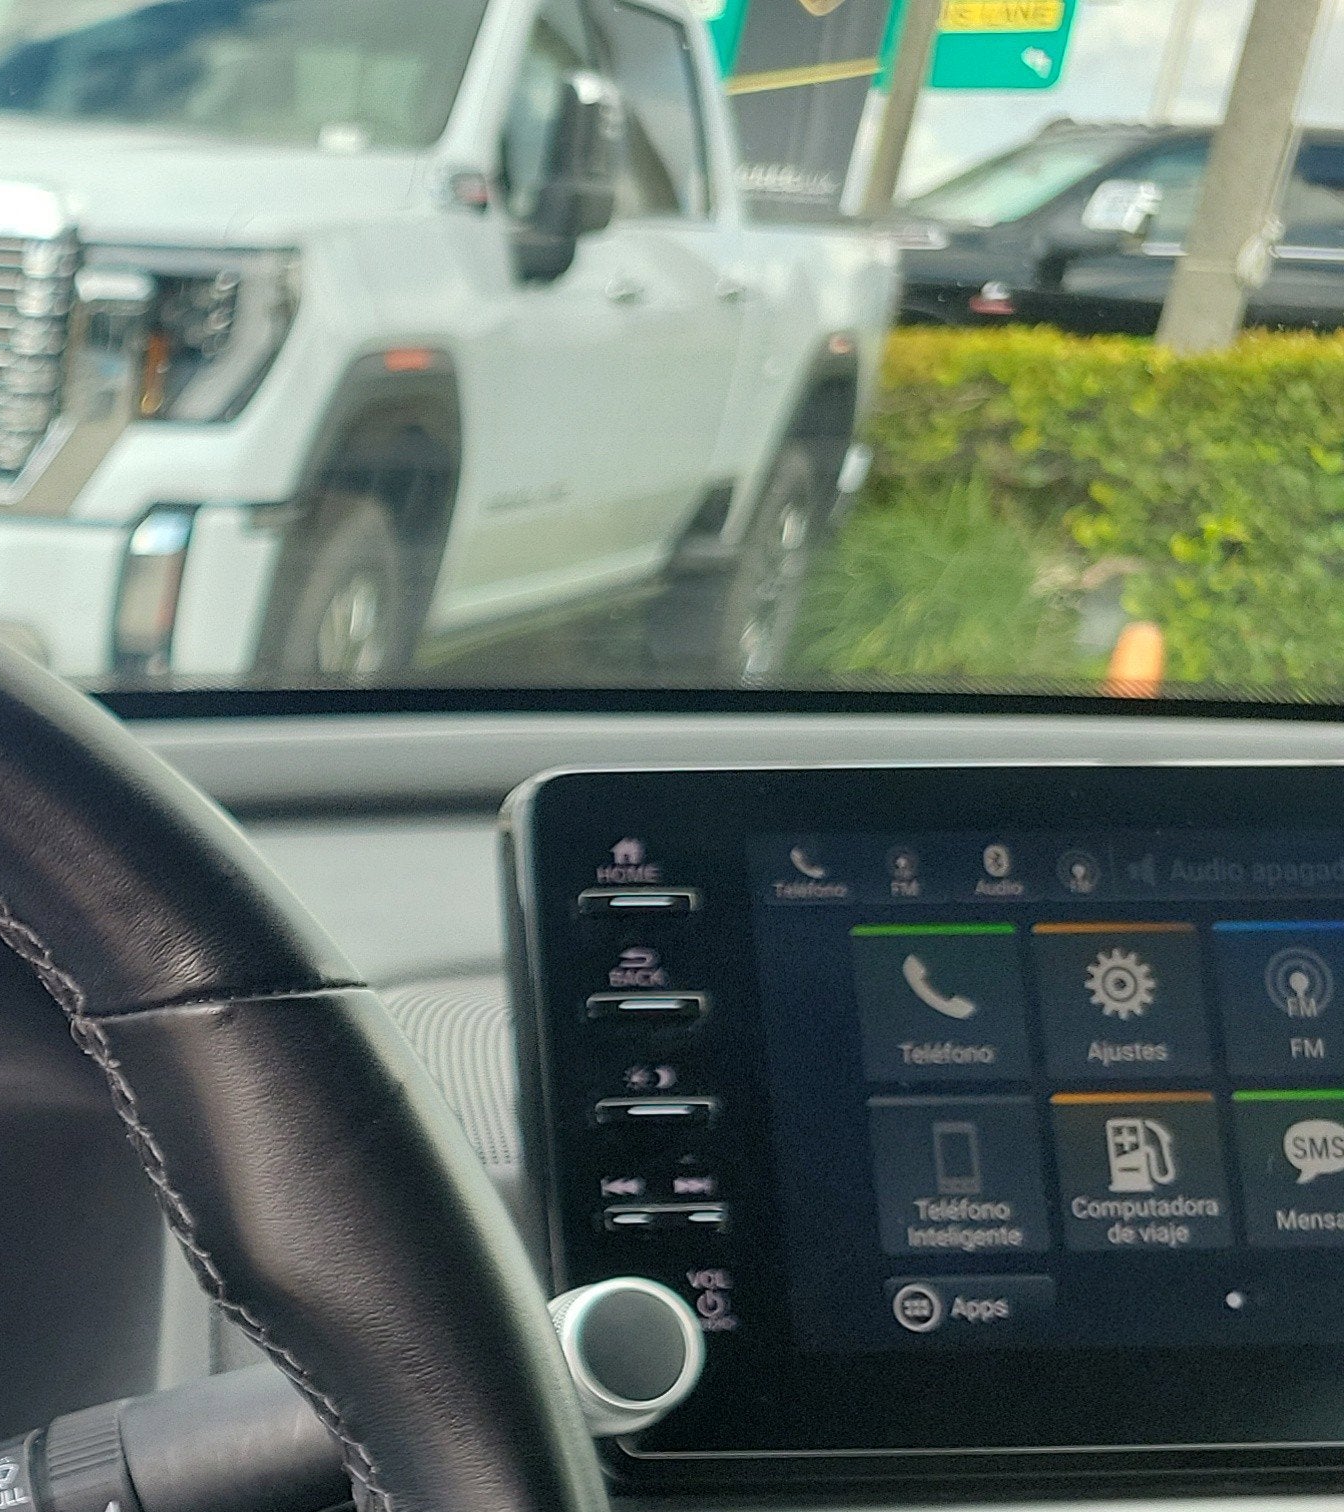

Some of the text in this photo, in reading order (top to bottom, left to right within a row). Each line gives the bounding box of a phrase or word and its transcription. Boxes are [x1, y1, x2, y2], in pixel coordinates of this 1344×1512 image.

[596, 865, 659, 884] HOME
[1287, 998, 1318, 1018] FM
[1087, 1041, 1170, 1067] Ajustes
[1290, 1037, 1325, 1059] FM
[1293, 1136, 1344, 1160] SMS
[1071, 1196, 1219, 1221] Computadora
[1108, 1222, 1190, 1247] de viaje
[951, 1296, 1010, 1323] Apps
